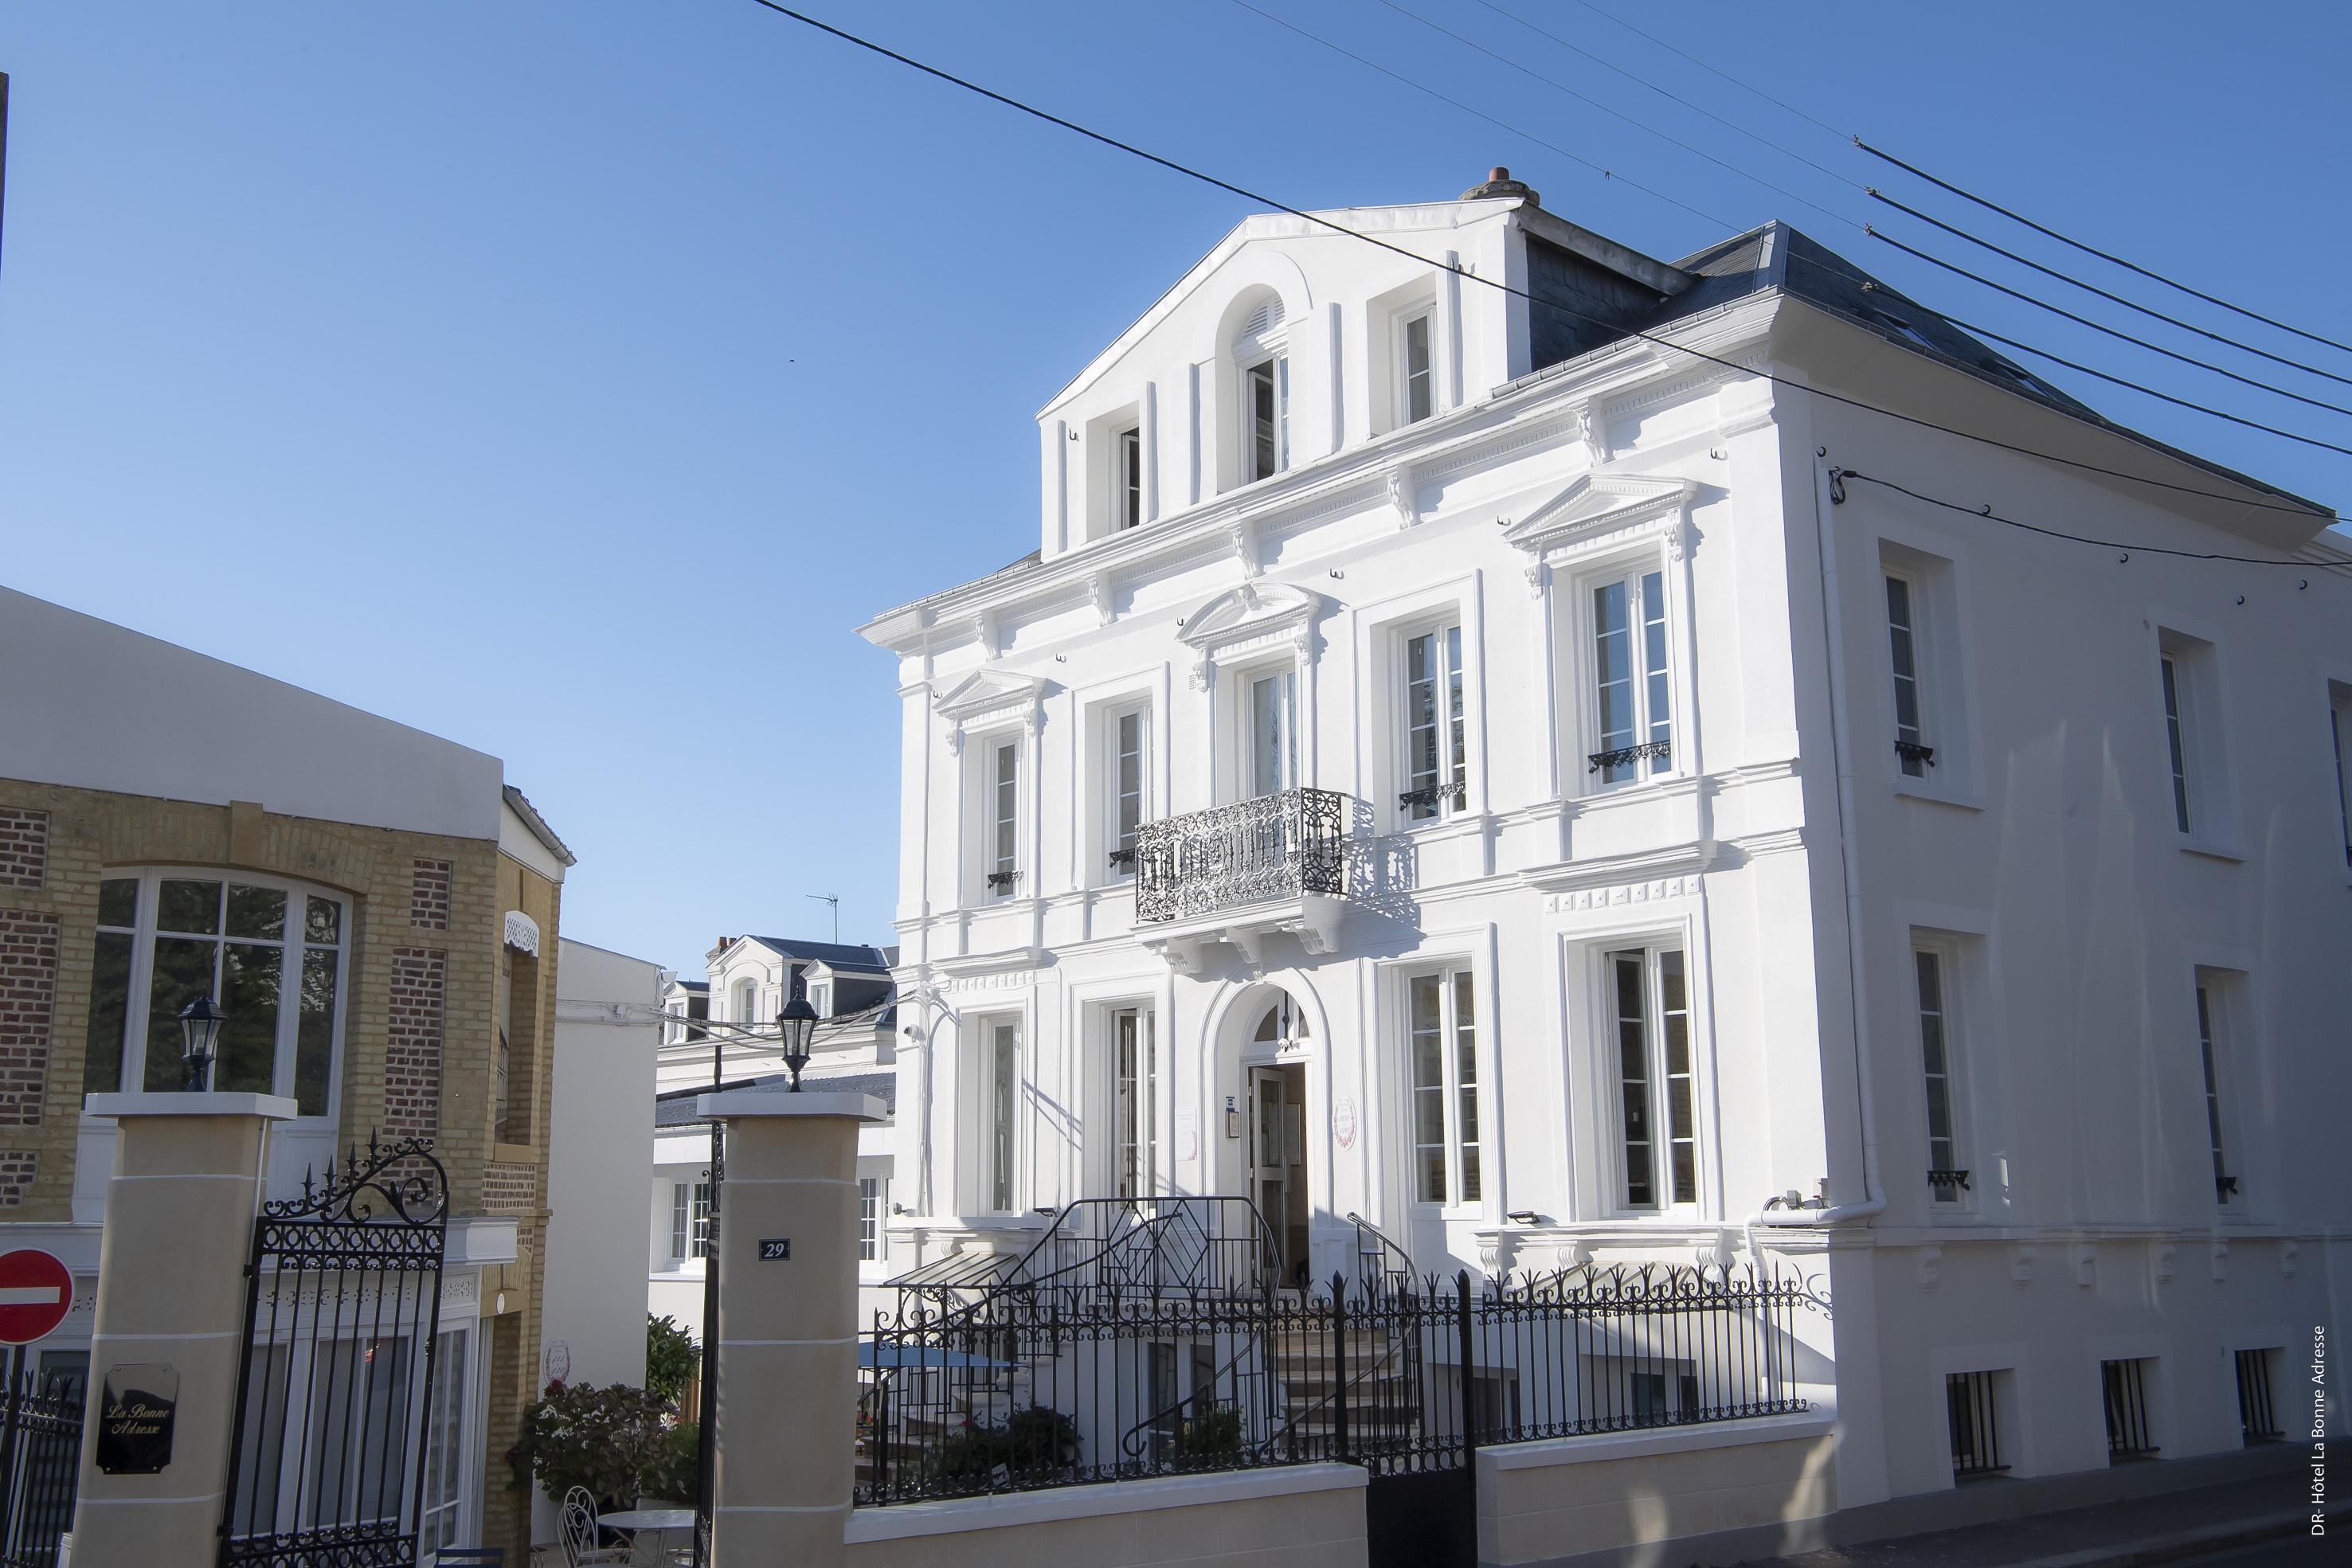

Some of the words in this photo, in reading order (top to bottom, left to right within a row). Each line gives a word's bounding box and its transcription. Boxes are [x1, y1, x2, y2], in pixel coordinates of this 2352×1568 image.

[765, 1243, 785, 1257] 29
[105, 1404, 127, 1418] La
[128, 1403, 170, 1418] Bonne
[112, 1420, 160, 1434] Adresse
